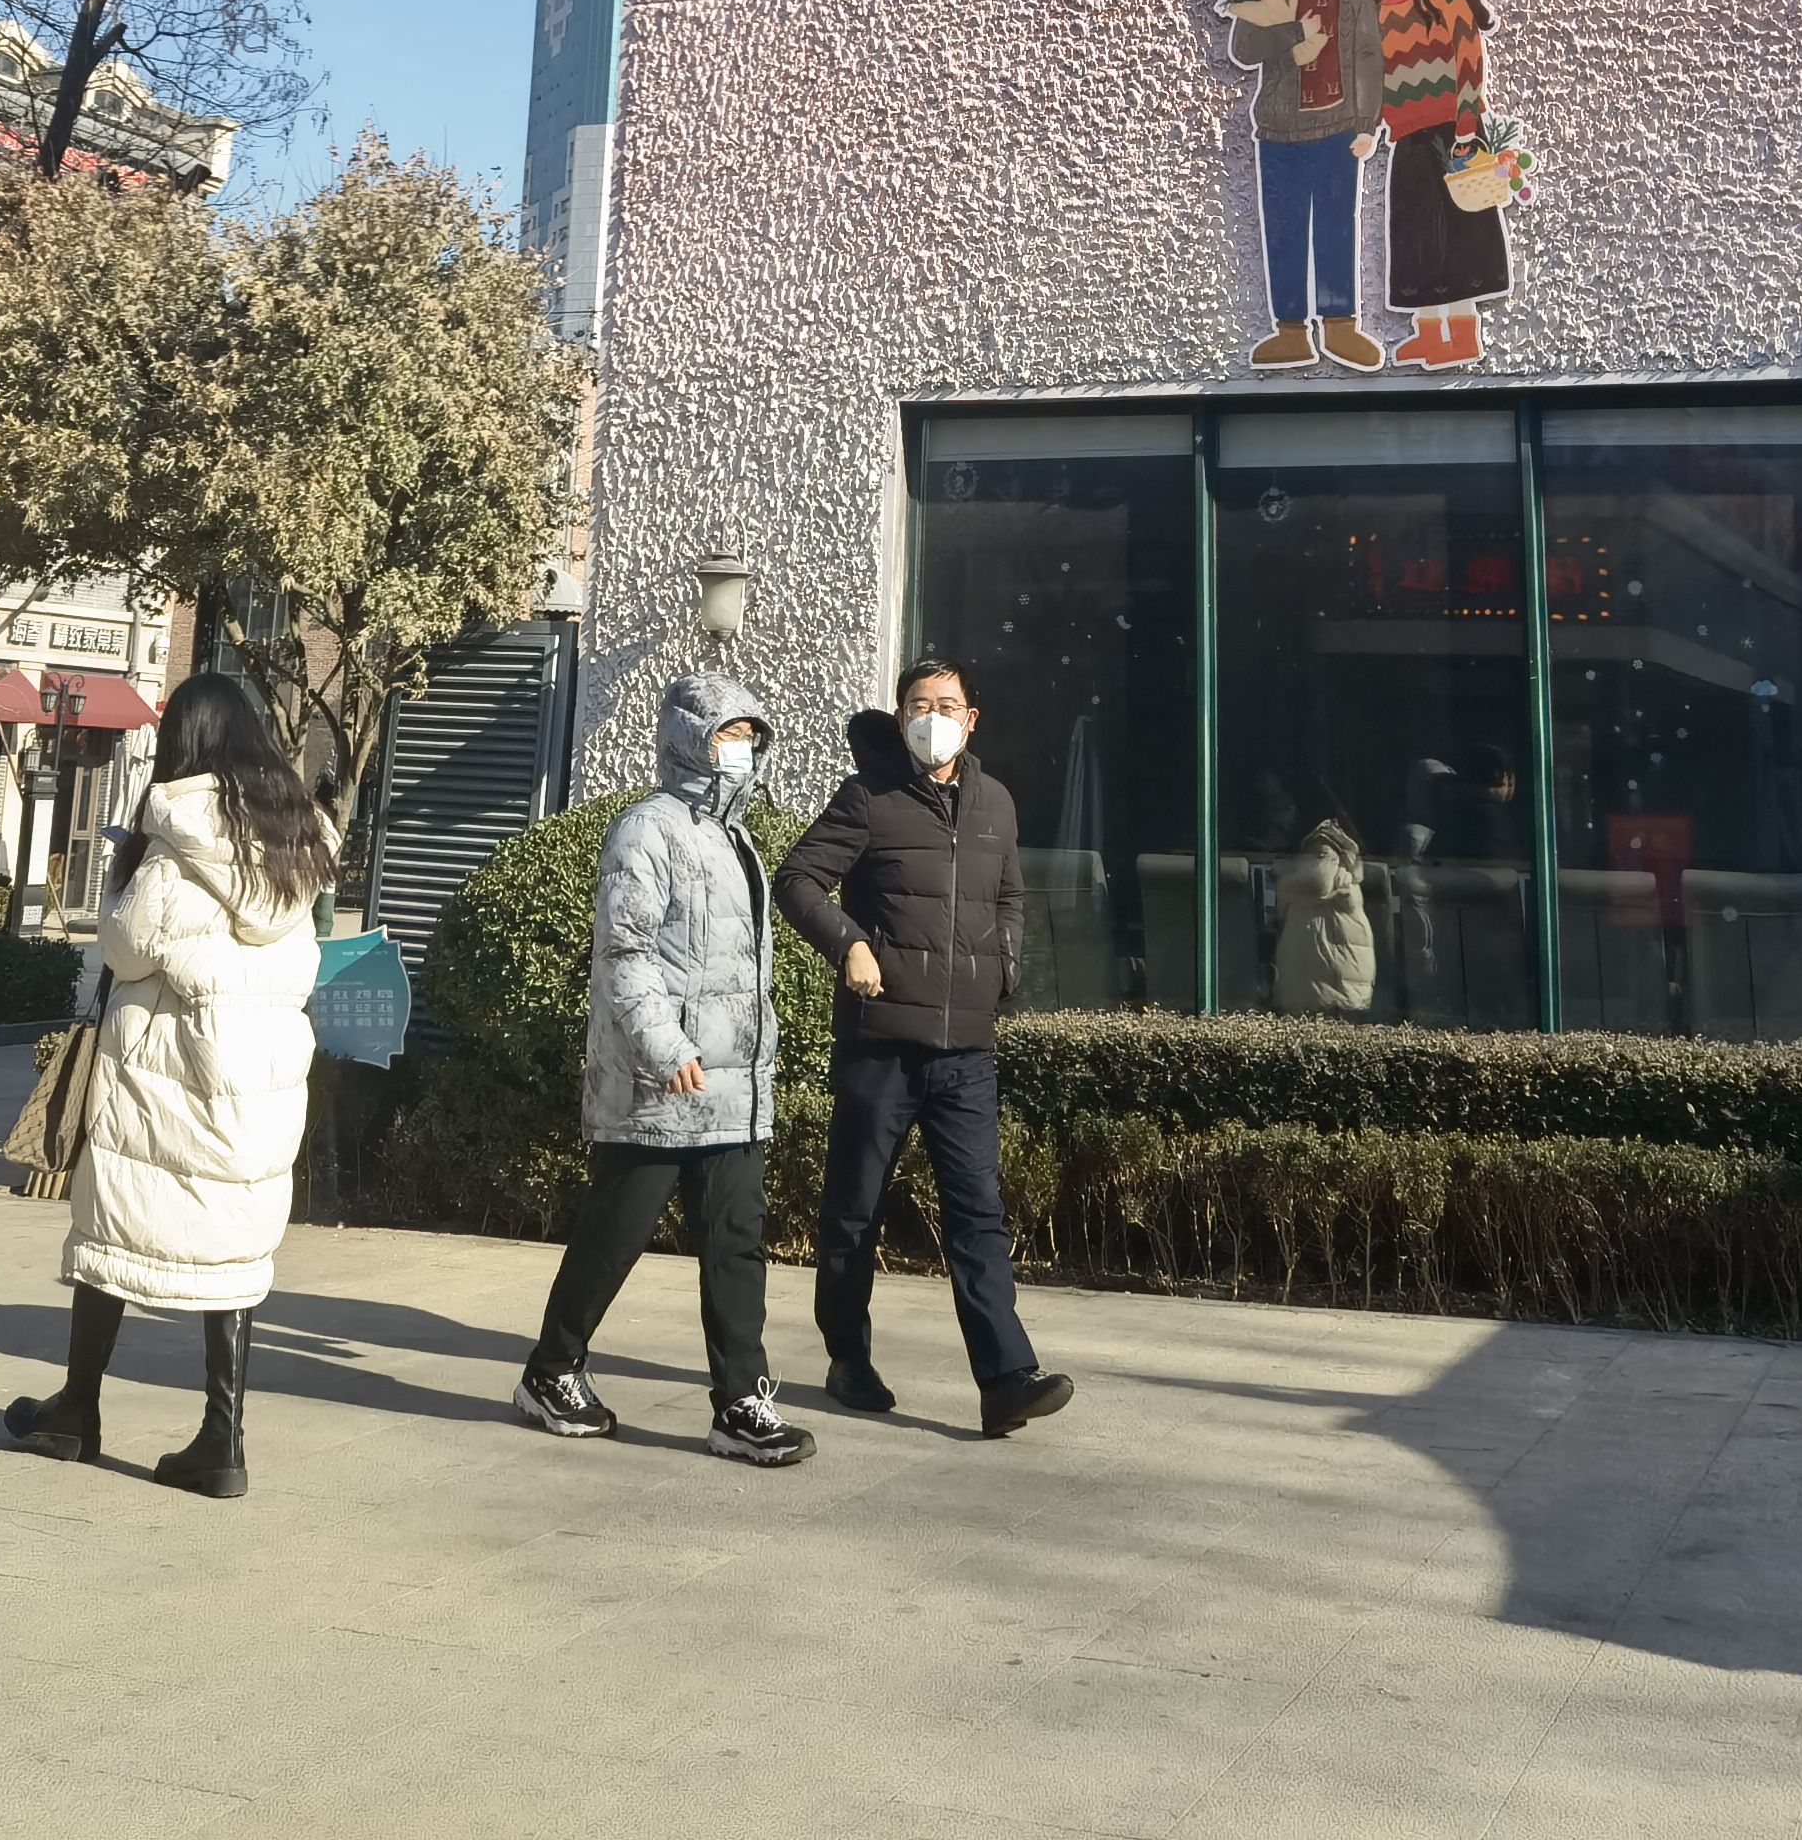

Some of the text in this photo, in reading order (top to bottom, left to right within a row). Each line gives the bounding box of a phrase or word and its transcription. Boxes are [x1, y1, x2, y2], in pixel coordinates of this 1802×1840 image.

[53, 623, 126, 653] 精致家常菜
